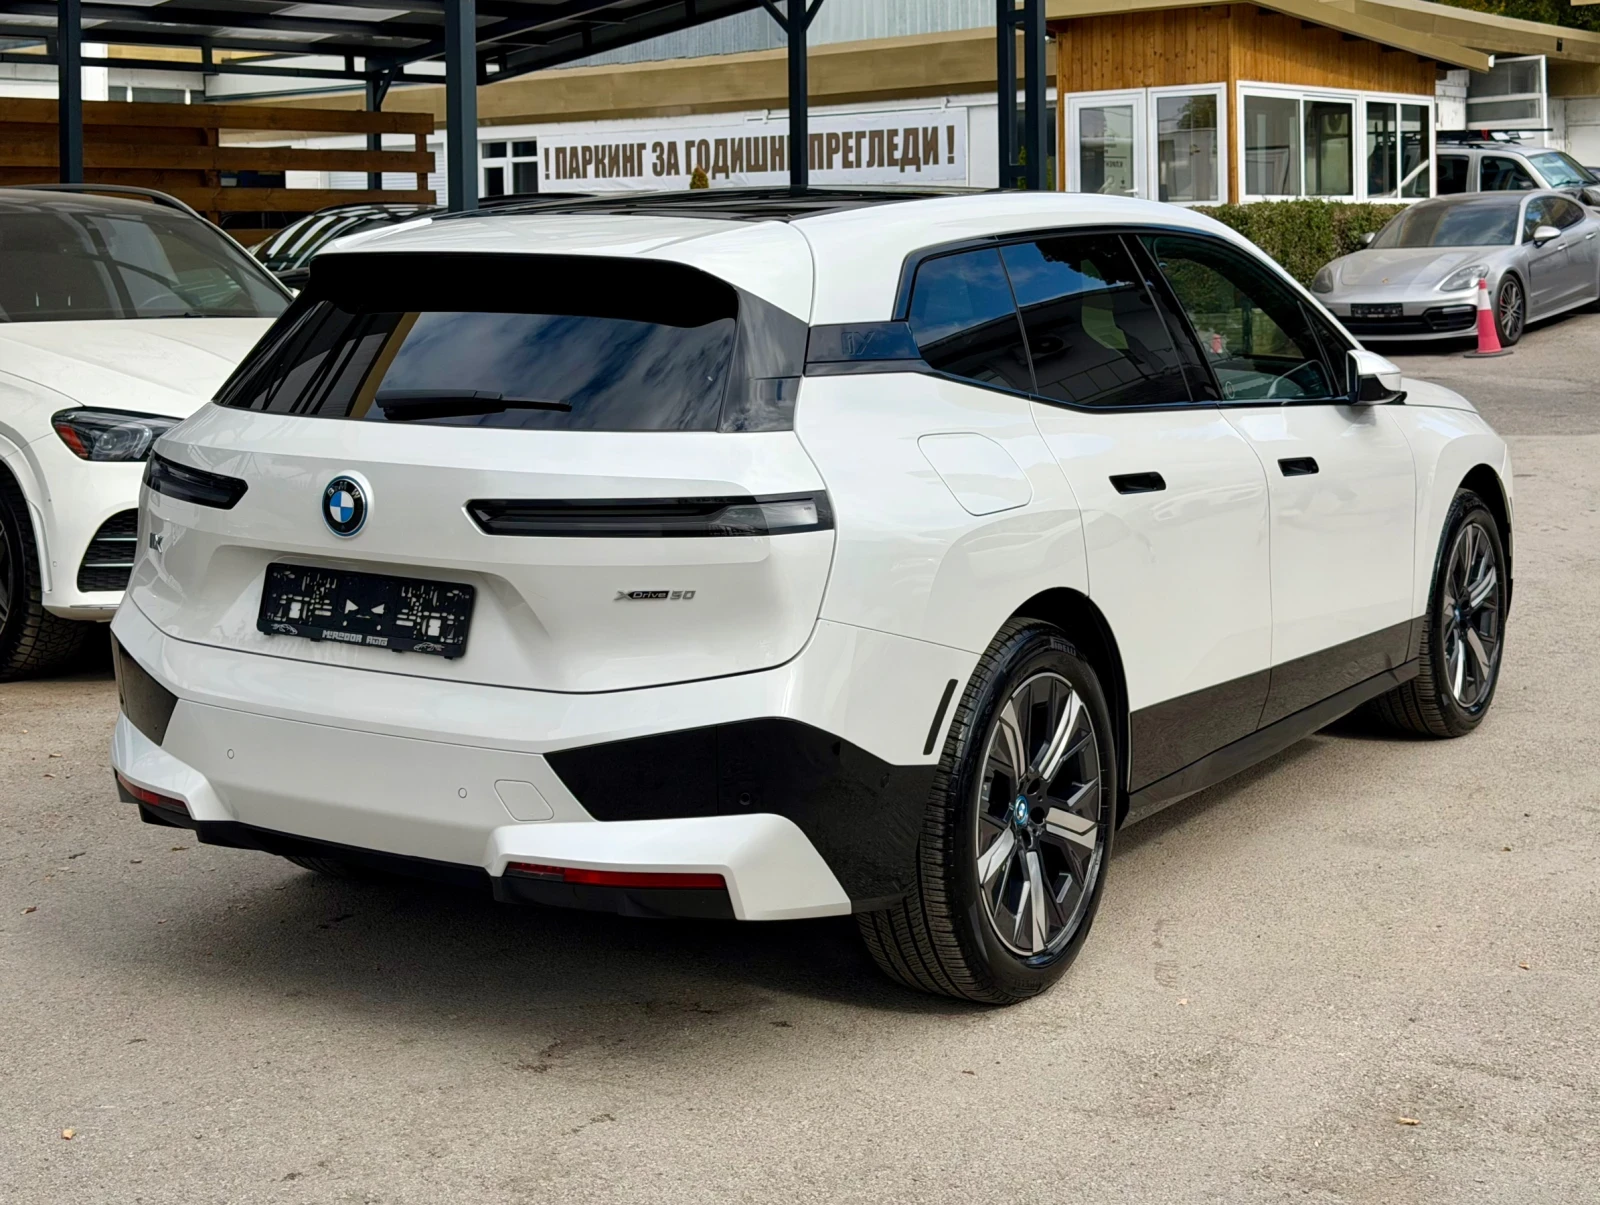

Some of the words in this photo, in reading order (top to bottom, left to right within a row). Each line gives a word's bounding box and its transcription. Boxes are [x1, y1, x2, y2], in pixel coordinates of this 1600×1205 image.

[555, 143, 647, 180] ПАРКИНГ
[651, 141, 679, 177] ЗА
[685, 134, 790, 180] ГОДИШН
[808, 126, 940, 173] ПРЕГЛЕДИ
[327, 481, 361, 499] BMW
